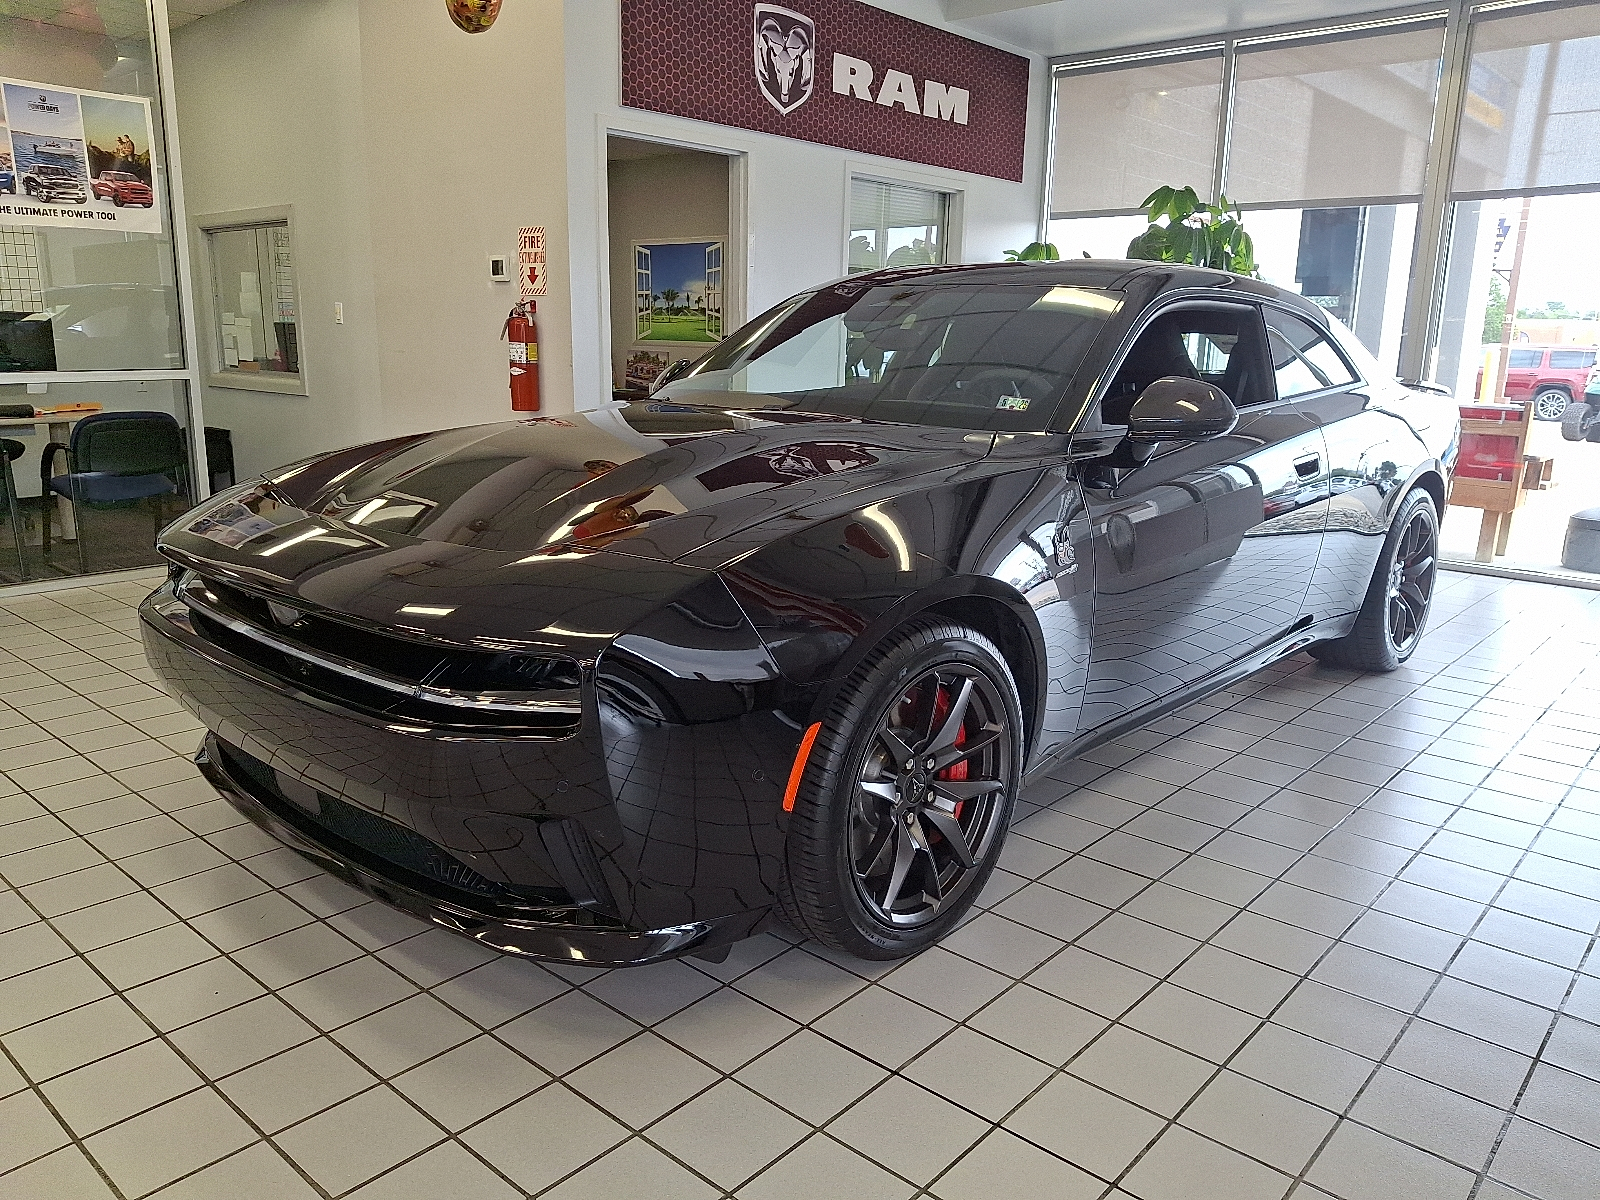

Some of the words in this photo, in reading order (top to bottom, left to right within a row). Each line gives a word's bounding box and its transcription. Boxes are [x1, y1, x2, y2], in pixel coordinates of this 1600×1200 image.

[832, 51, 970, 126] RAM
[14, 206, 58, 217] ULTIMATE
[61, 209, 94, 219] POWER
[96, 211, 117, 221] TOOL
[523, 235, 541, 249] FIRE
